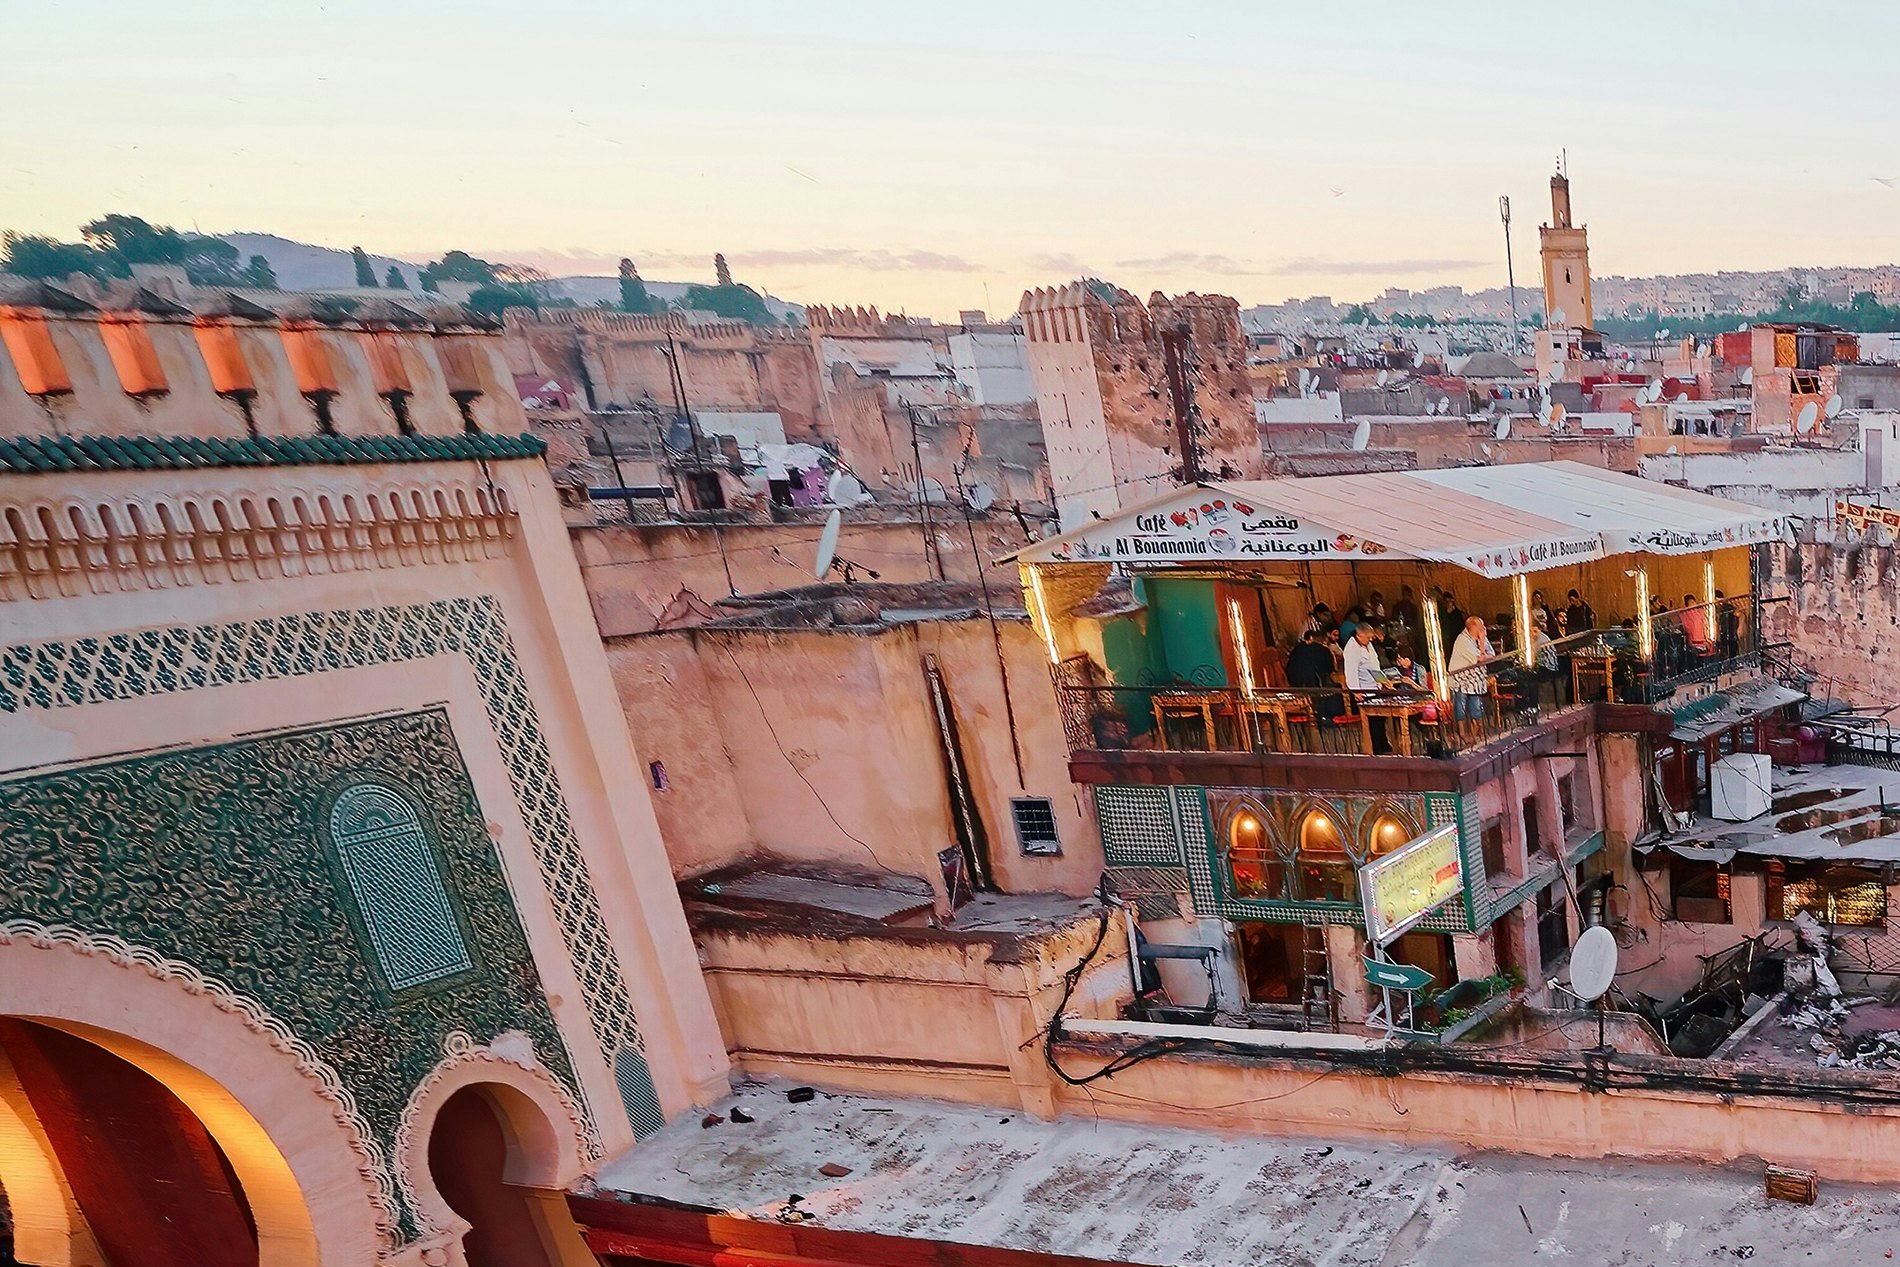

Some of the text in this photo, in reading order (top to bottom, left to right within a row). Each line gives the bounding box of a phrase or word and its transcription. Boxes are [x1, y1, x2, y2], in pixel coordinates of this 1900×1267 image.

[1136, 514, 1166, 533] Café
[1242, 515, 1298, 531] مقهى
[1116, 537, 1206, 555] Al Bouanania
[1240, 538, 1329, 556] البوعنانية
[1529, 543, 1548, 561] Café
